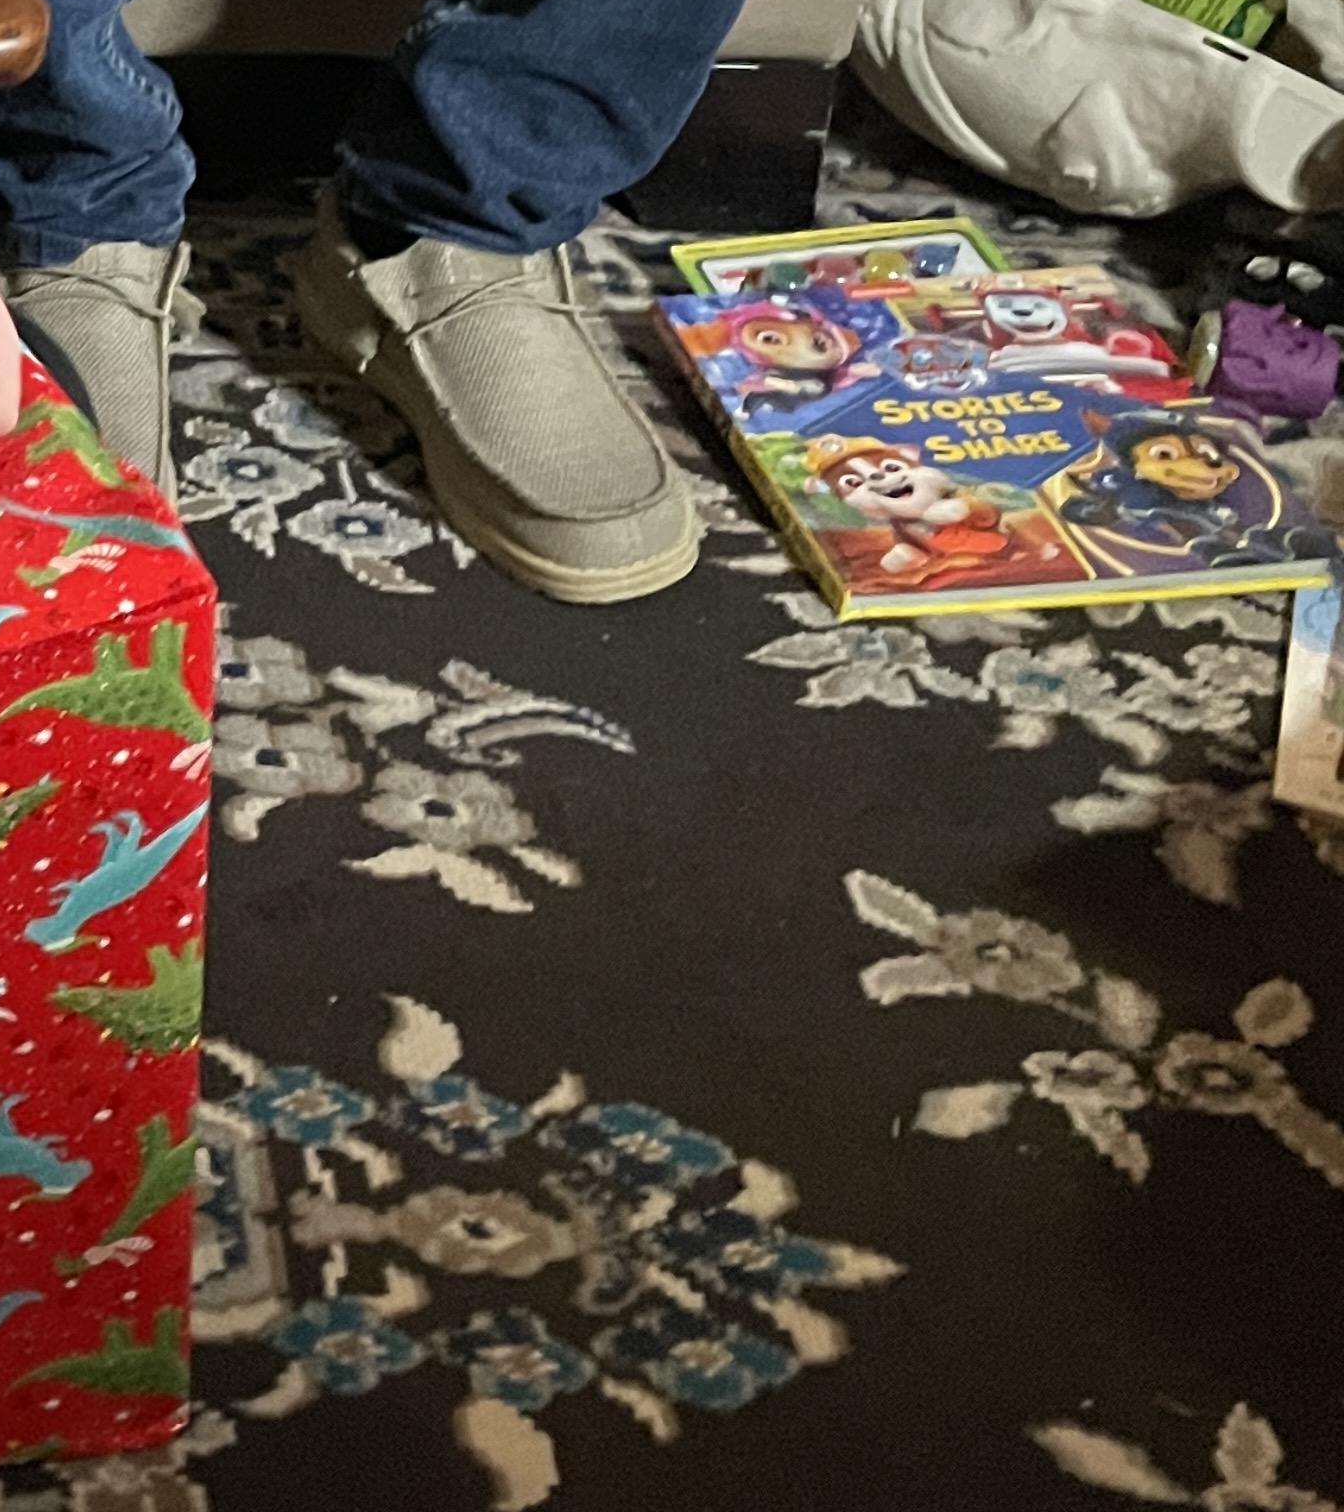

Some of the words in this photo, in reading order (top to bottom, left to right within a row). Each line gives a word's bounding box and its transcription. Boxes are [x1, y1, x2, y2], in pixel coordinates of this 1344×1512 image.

[873, 390, 1063, 425] STORIES
[957, 417, 1006, 437] TO
[924, 429, 1072, 463] SHARE
